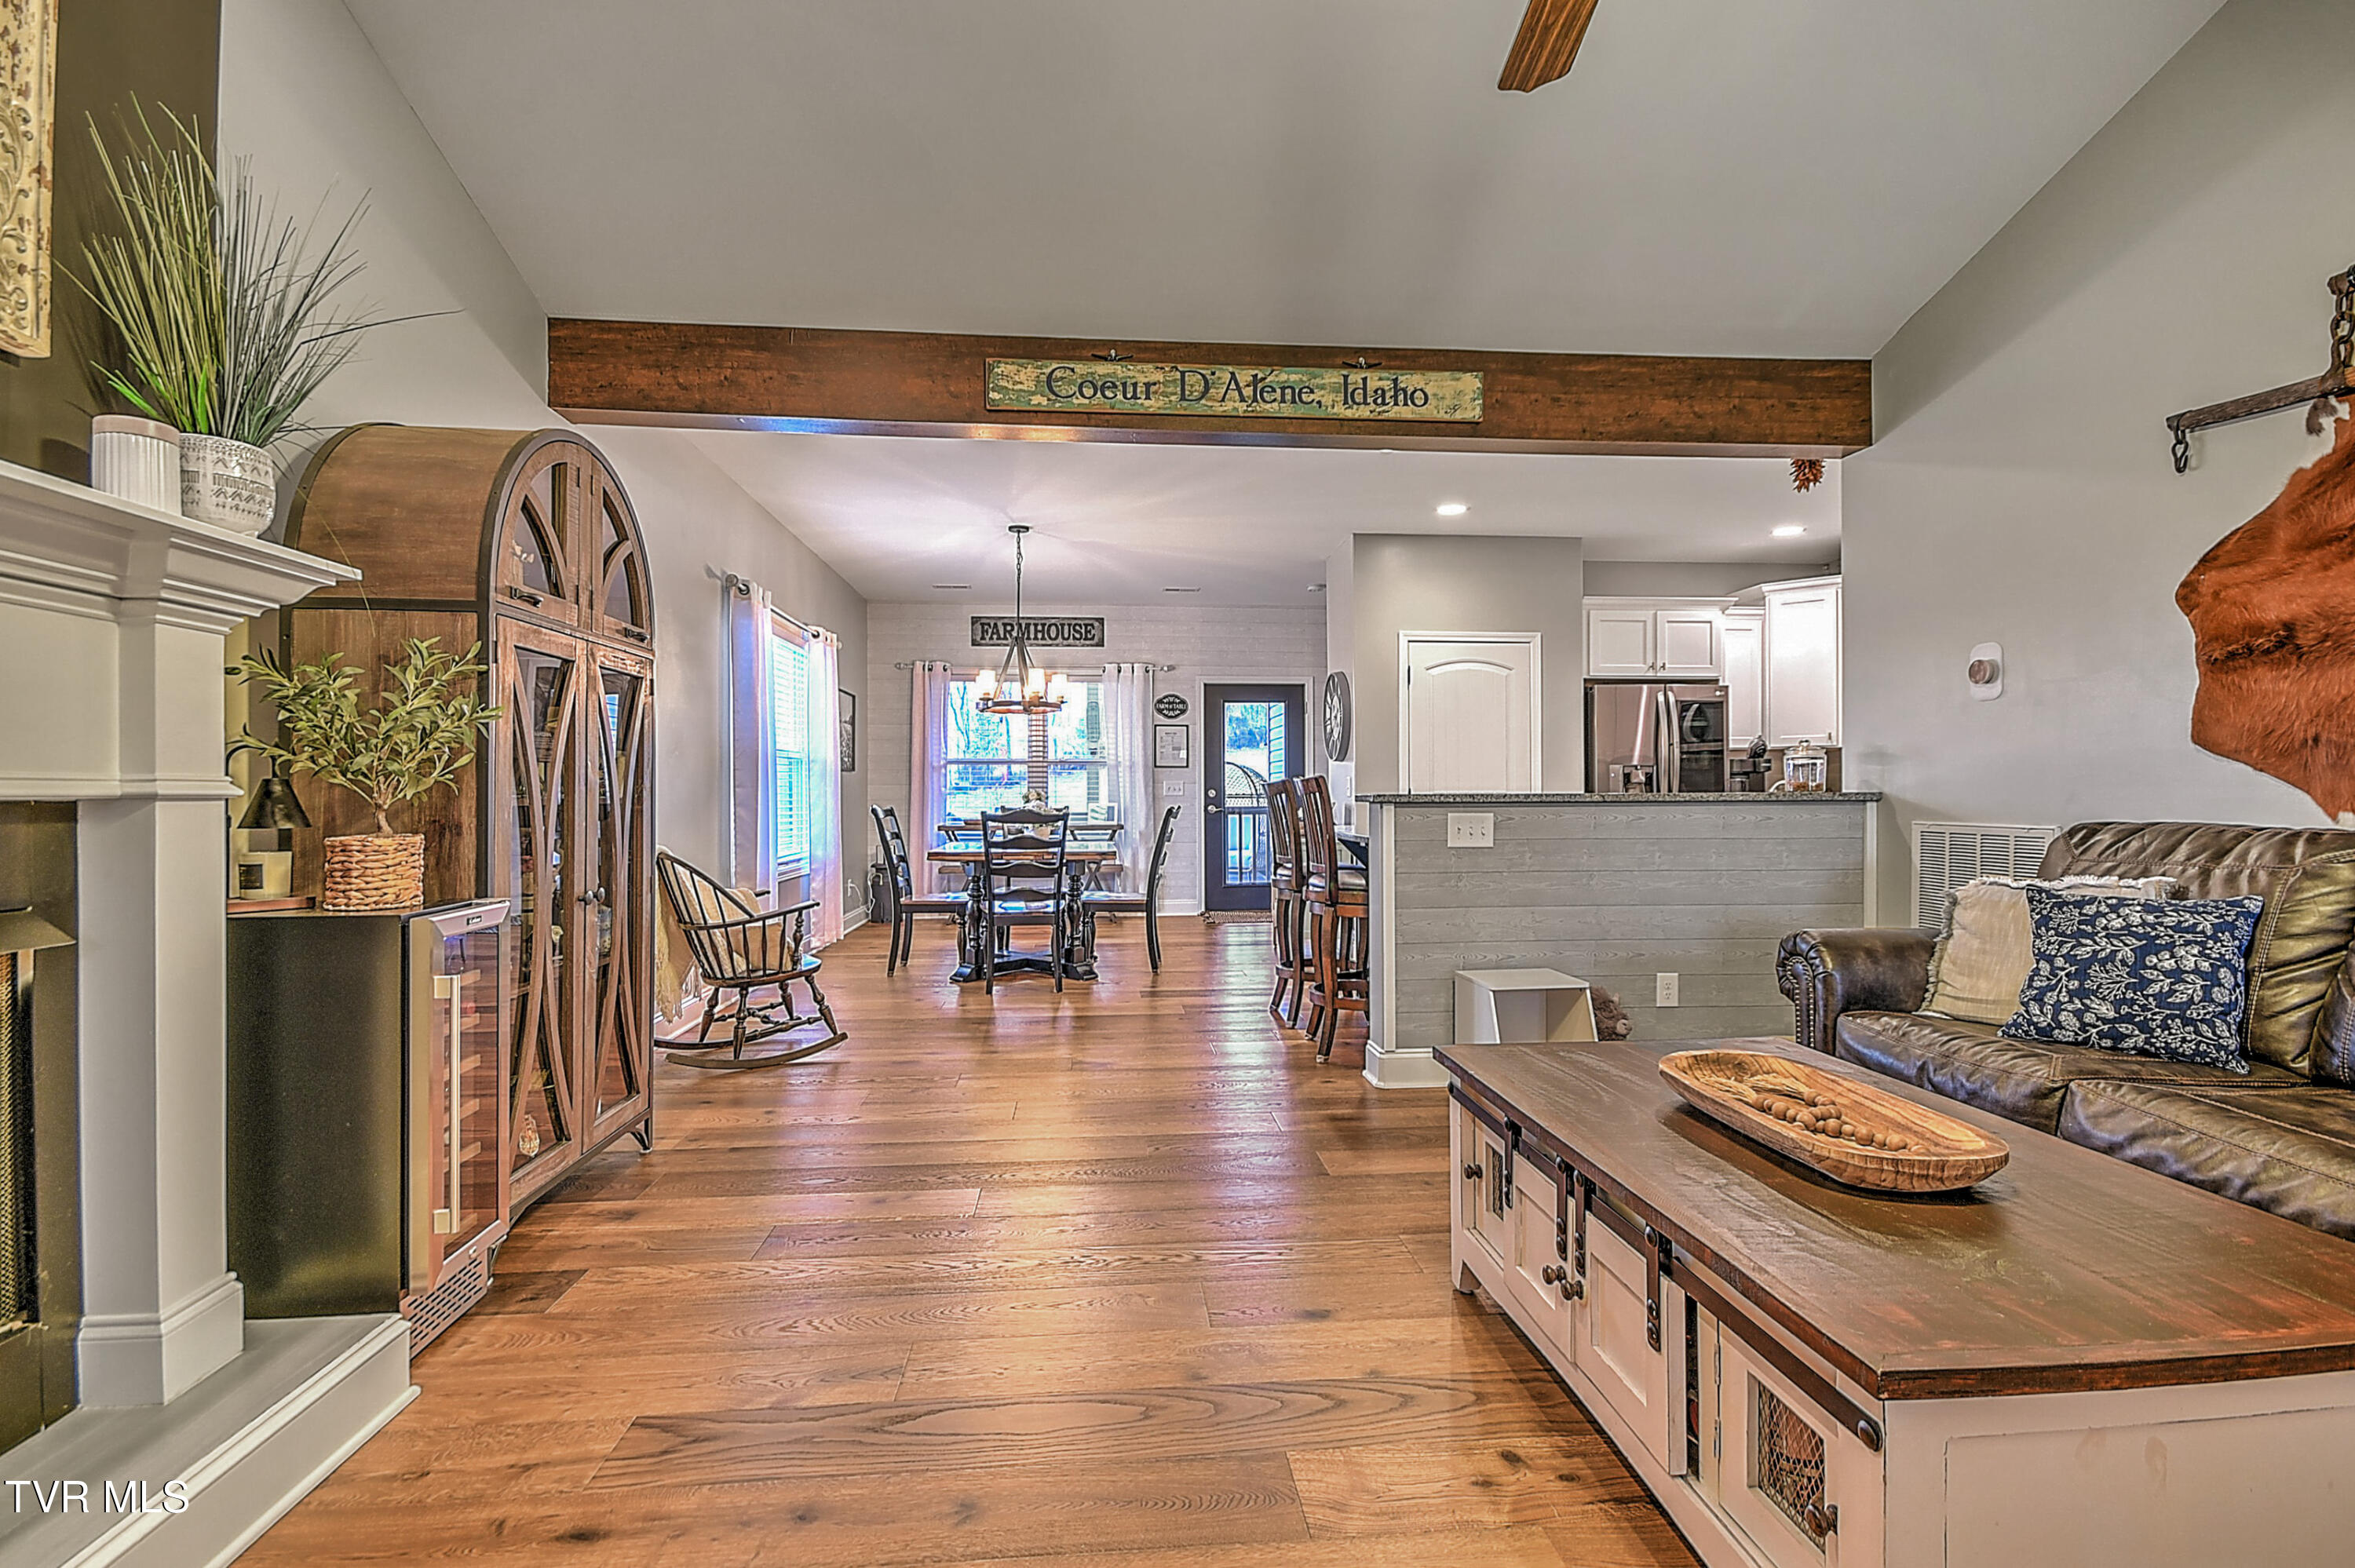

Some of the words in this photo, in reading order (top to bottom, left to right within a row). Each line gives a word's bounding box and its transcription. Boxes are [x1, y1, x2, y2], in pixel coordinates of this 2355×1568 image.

[1046, 365, 1158, 401] Coeur
[1342, 373, 1429, 408] Idaho
[979, 622, 1096, 642] FARMHOUSE
